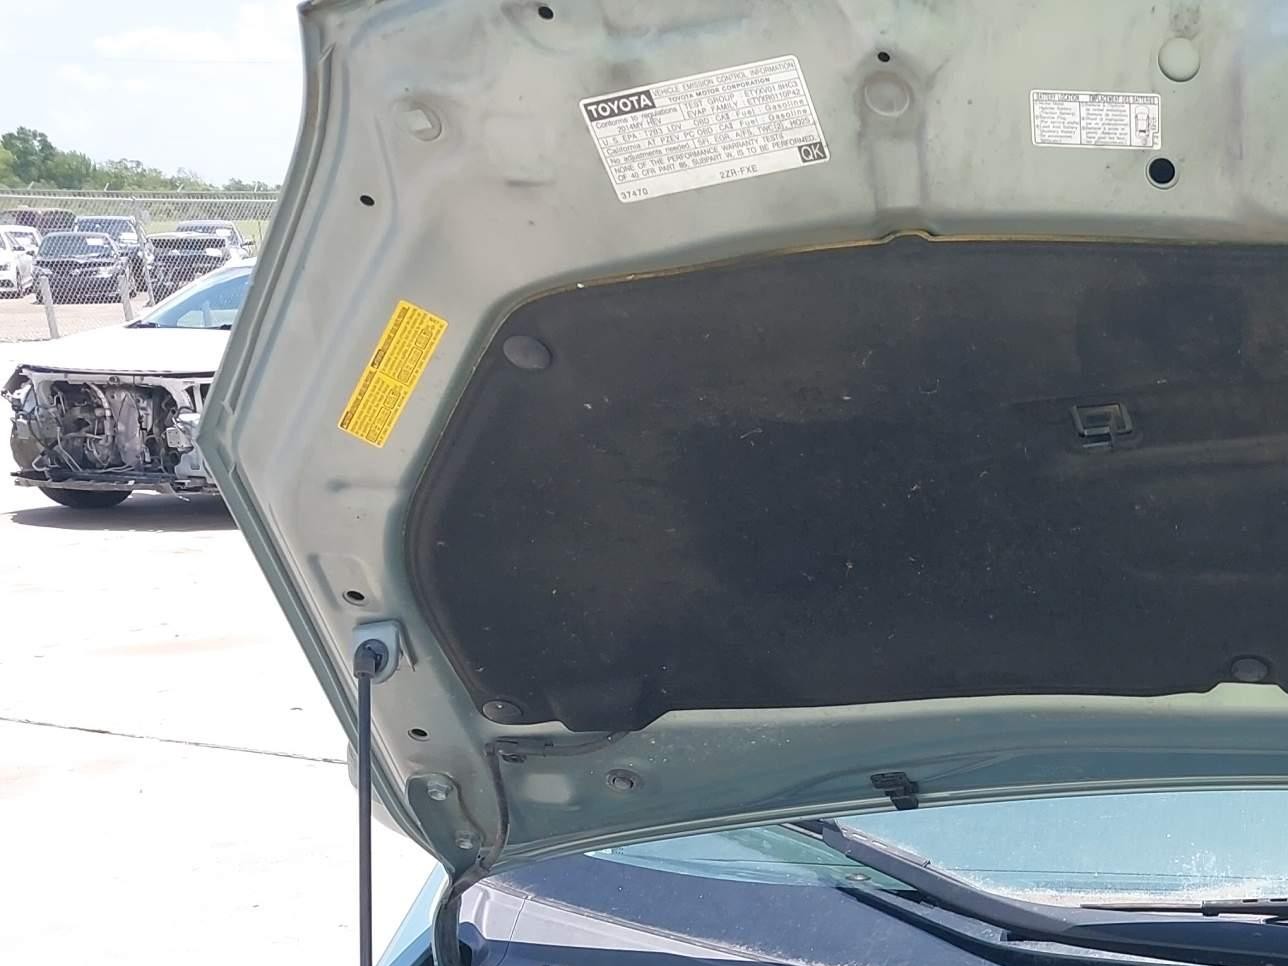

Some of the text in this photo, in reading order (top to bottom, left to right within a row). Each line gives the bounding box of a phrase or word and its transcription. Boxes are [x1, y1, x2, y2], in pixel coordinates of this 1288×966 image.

[652, 61, 794, 97] VEHICLE EMISSION CONTROL INFORMATION
[667, 76, 770, 103] TOYOTA MOTOR CORPORATION
[587, 93, 652, 119] TOYOTA
[683, 100, 703, 110] TEST
[706, 93, 735, 105] GROUP
[686, 107, 707, 118] EVAP
[709, 100, 739, 113] FAMILY
[735, 107, 755, 118] Fuel
[763, 97, 804, 112] Gasoline
[594, 106, 678, 129] Conforms to regulations
[605, 142, 641, 155] California
[738, 117, 758, 127] Fuel
[767, 106, 807, 121] Gasoline
[613, 164, 633, 174] NONE
[636, 161, 647, 169] OF
[649, 157, 664, 166] THE
[666, 146, 719, 163] PERFORMANCE
[721, 137, 759, 151] WARRANTY
[622, 148, 663, 163] adjustments
[690, 153, 723, 166] SUBPART
[746, 146, 757, 154] TO
[799, 143, 825, 161] QK
[718, 163, 758, 179] 2ZR-FXE
